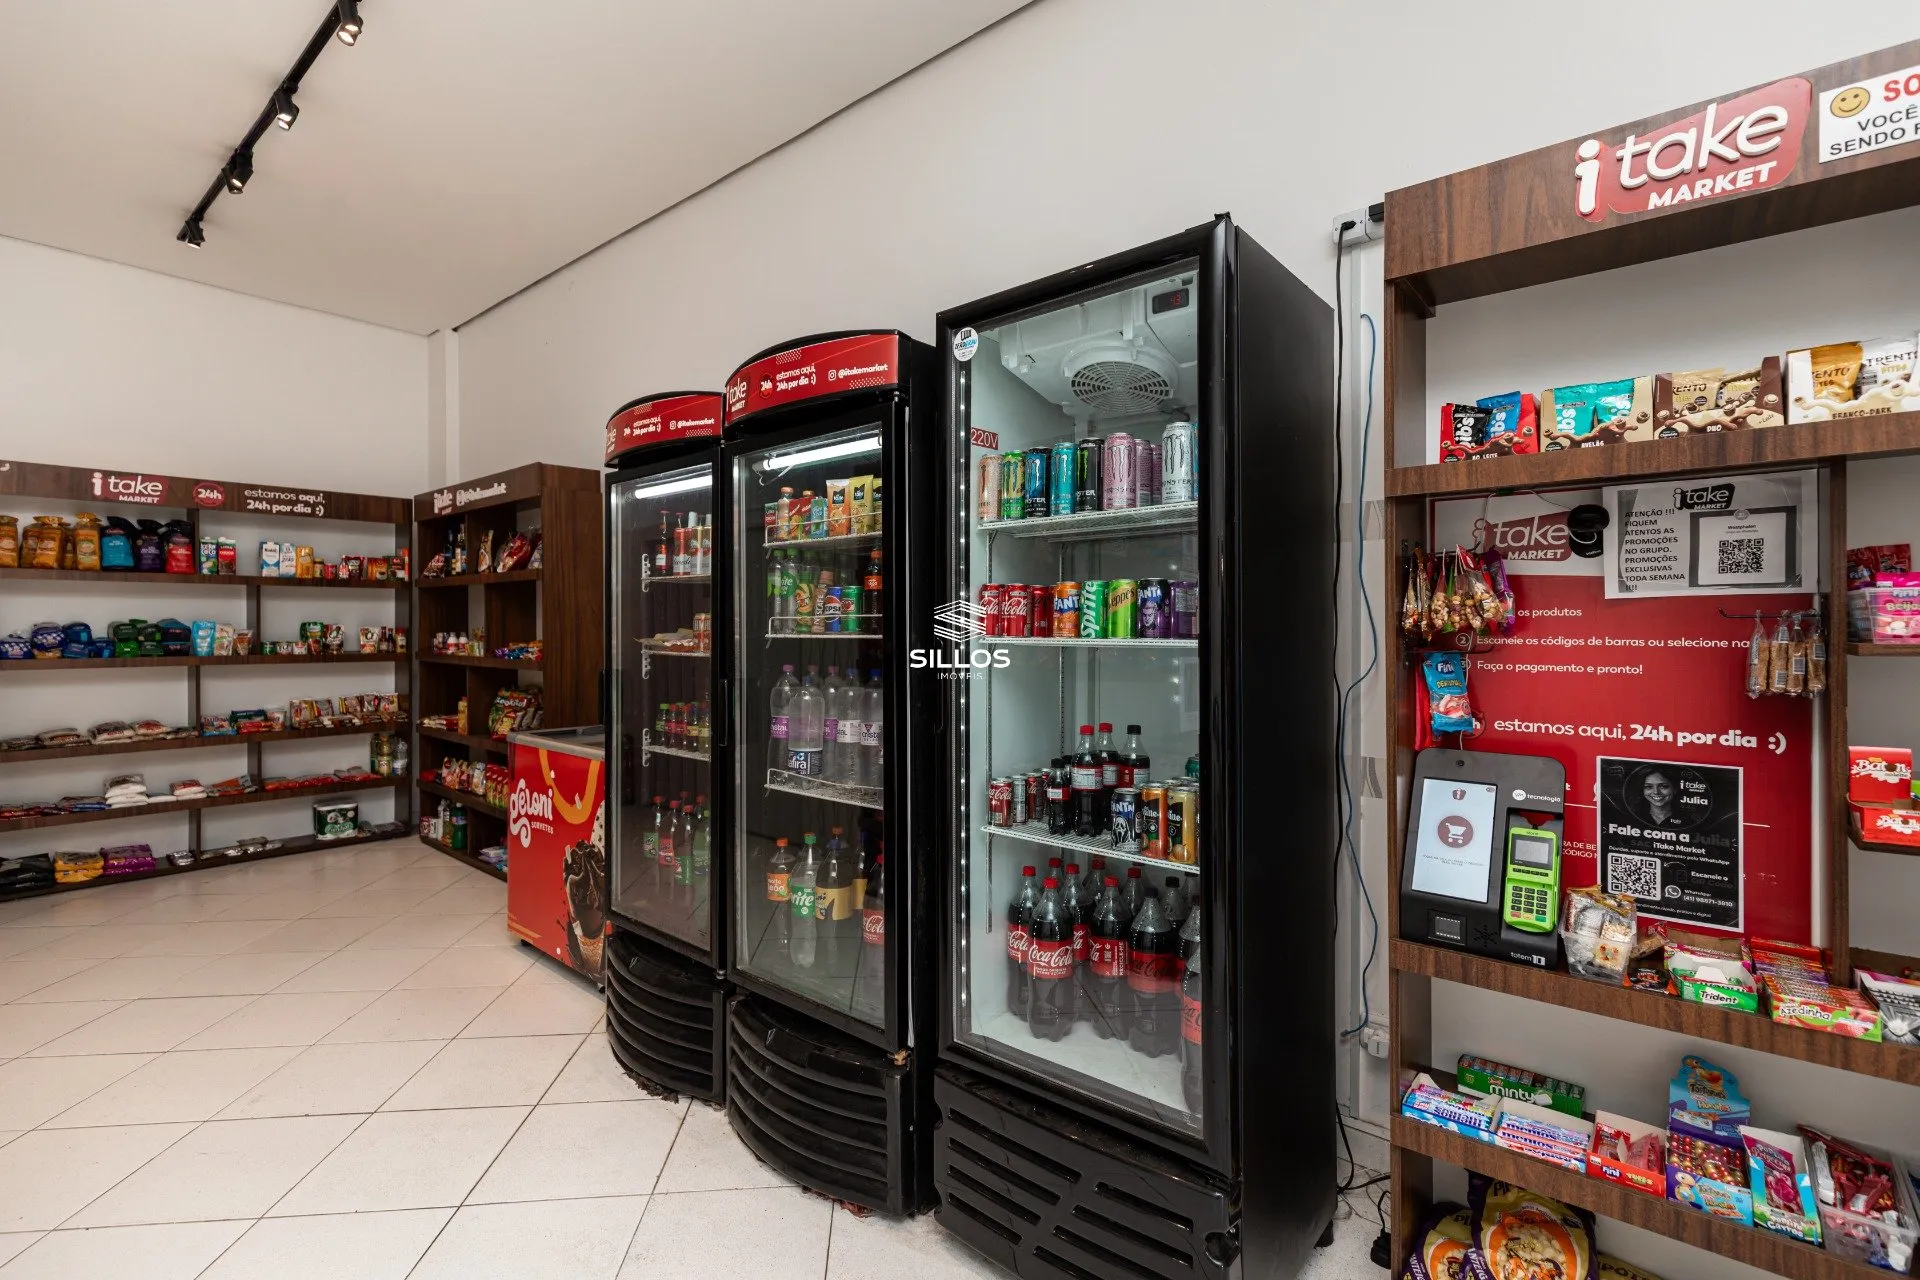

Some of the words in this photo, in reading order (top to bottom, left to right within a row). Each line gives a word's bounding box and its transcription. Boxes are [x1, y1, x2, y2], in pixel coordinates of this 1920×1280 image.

[1857, 104, 1918, 131] VOCÊ
[1616, 103, 1788, 188] take
[1830, 127, 1906, 156] SENDO
[1647, 160, 1777, 210] MARKET
[776, 370, 800, 380] estamos
[776, 381, 789, 391] 24h
[789, 379, 798, 390] por
[799, 376, 809, 386] dia
[971, 428, 998, 449] 220V
[107, 475, 163, 496] take
[119, 495, 160, 504] MARKET
[197, 488, 222, 500] 24h
[244, 488, 297, 501] estamos
[298, 493, 326, 504] aqui,
[1685, 487, 1730, 503] take
[246, 499, 271, 511] 24h
[271, 504, 293, 514] por
[293, 503, 312, 514] dia
[1693, 502, 1727, 510] MARKET
[1625, 509, 1663, 518] ATENÇÃO
[1625, 519, 1658, 527] FIQUEM
[1493, 515, 1570, 548] take
[1625, 528, 1662, 536] ATENTOS
[1625, 536, 1679, 546] PROMOÇÕES
[1507, 549, 1565, 560] MARKET
[1625, 547, 1638, 555] NO
[1625, 555, 1678, 564] PROMOÇÕES
[1625, 565, 1673, 573] EXCLUSIVAS
[1648, 573, 1686, 581] SEMANA
[1517, 609, 1530, 617] os
[1532, 607, 1582, 619] produtos
[1476, 635, 1524, 645] Escaneie
[1540, 635, 1581, 647] códigos
[1587, 636, 1603, 646] de
[1605, 636, 1645, 647] barras
[1647, 639, 1665, 647] ou
[1667, 637, 1729, 648] selecione
[1731, 639, 1750, 648] na
[1477, 660, 1504, 673] Faça
[1515, 663, 1584, 675] pagamento
[1586, 665, 1595, 673] e
[1597, 665, 1643, 675] pronto!
[1494, 718, 1575, 736] estamos
[1578, 724, 1627, 742] aqui,
[1630, 723, 1674, 742] 24h
[1677, 730, 1717, 748] por
[1719, 729, 1758, 749] dia
[1679, 795, 1708, 806] Julia
[1608, 823, 1641, 838] Fale
[1643, 829, 1677, 842] com
[1679, 832, 1690, 843] a
[1573, 841, 1585, 849] DE
[1653, 841, 1675, 851] iTake
[1675, 845, 1707, 855] Market
[1691, 870, 1722, 881] Escaneie
[1028, 944, 1073, 967] Coca-Cola
[1700, 990, 1738, 1004] Trident
[1780, 1006, 1831, 1020] Azedinha
[1490, 1084, 1535, 1104] minty
